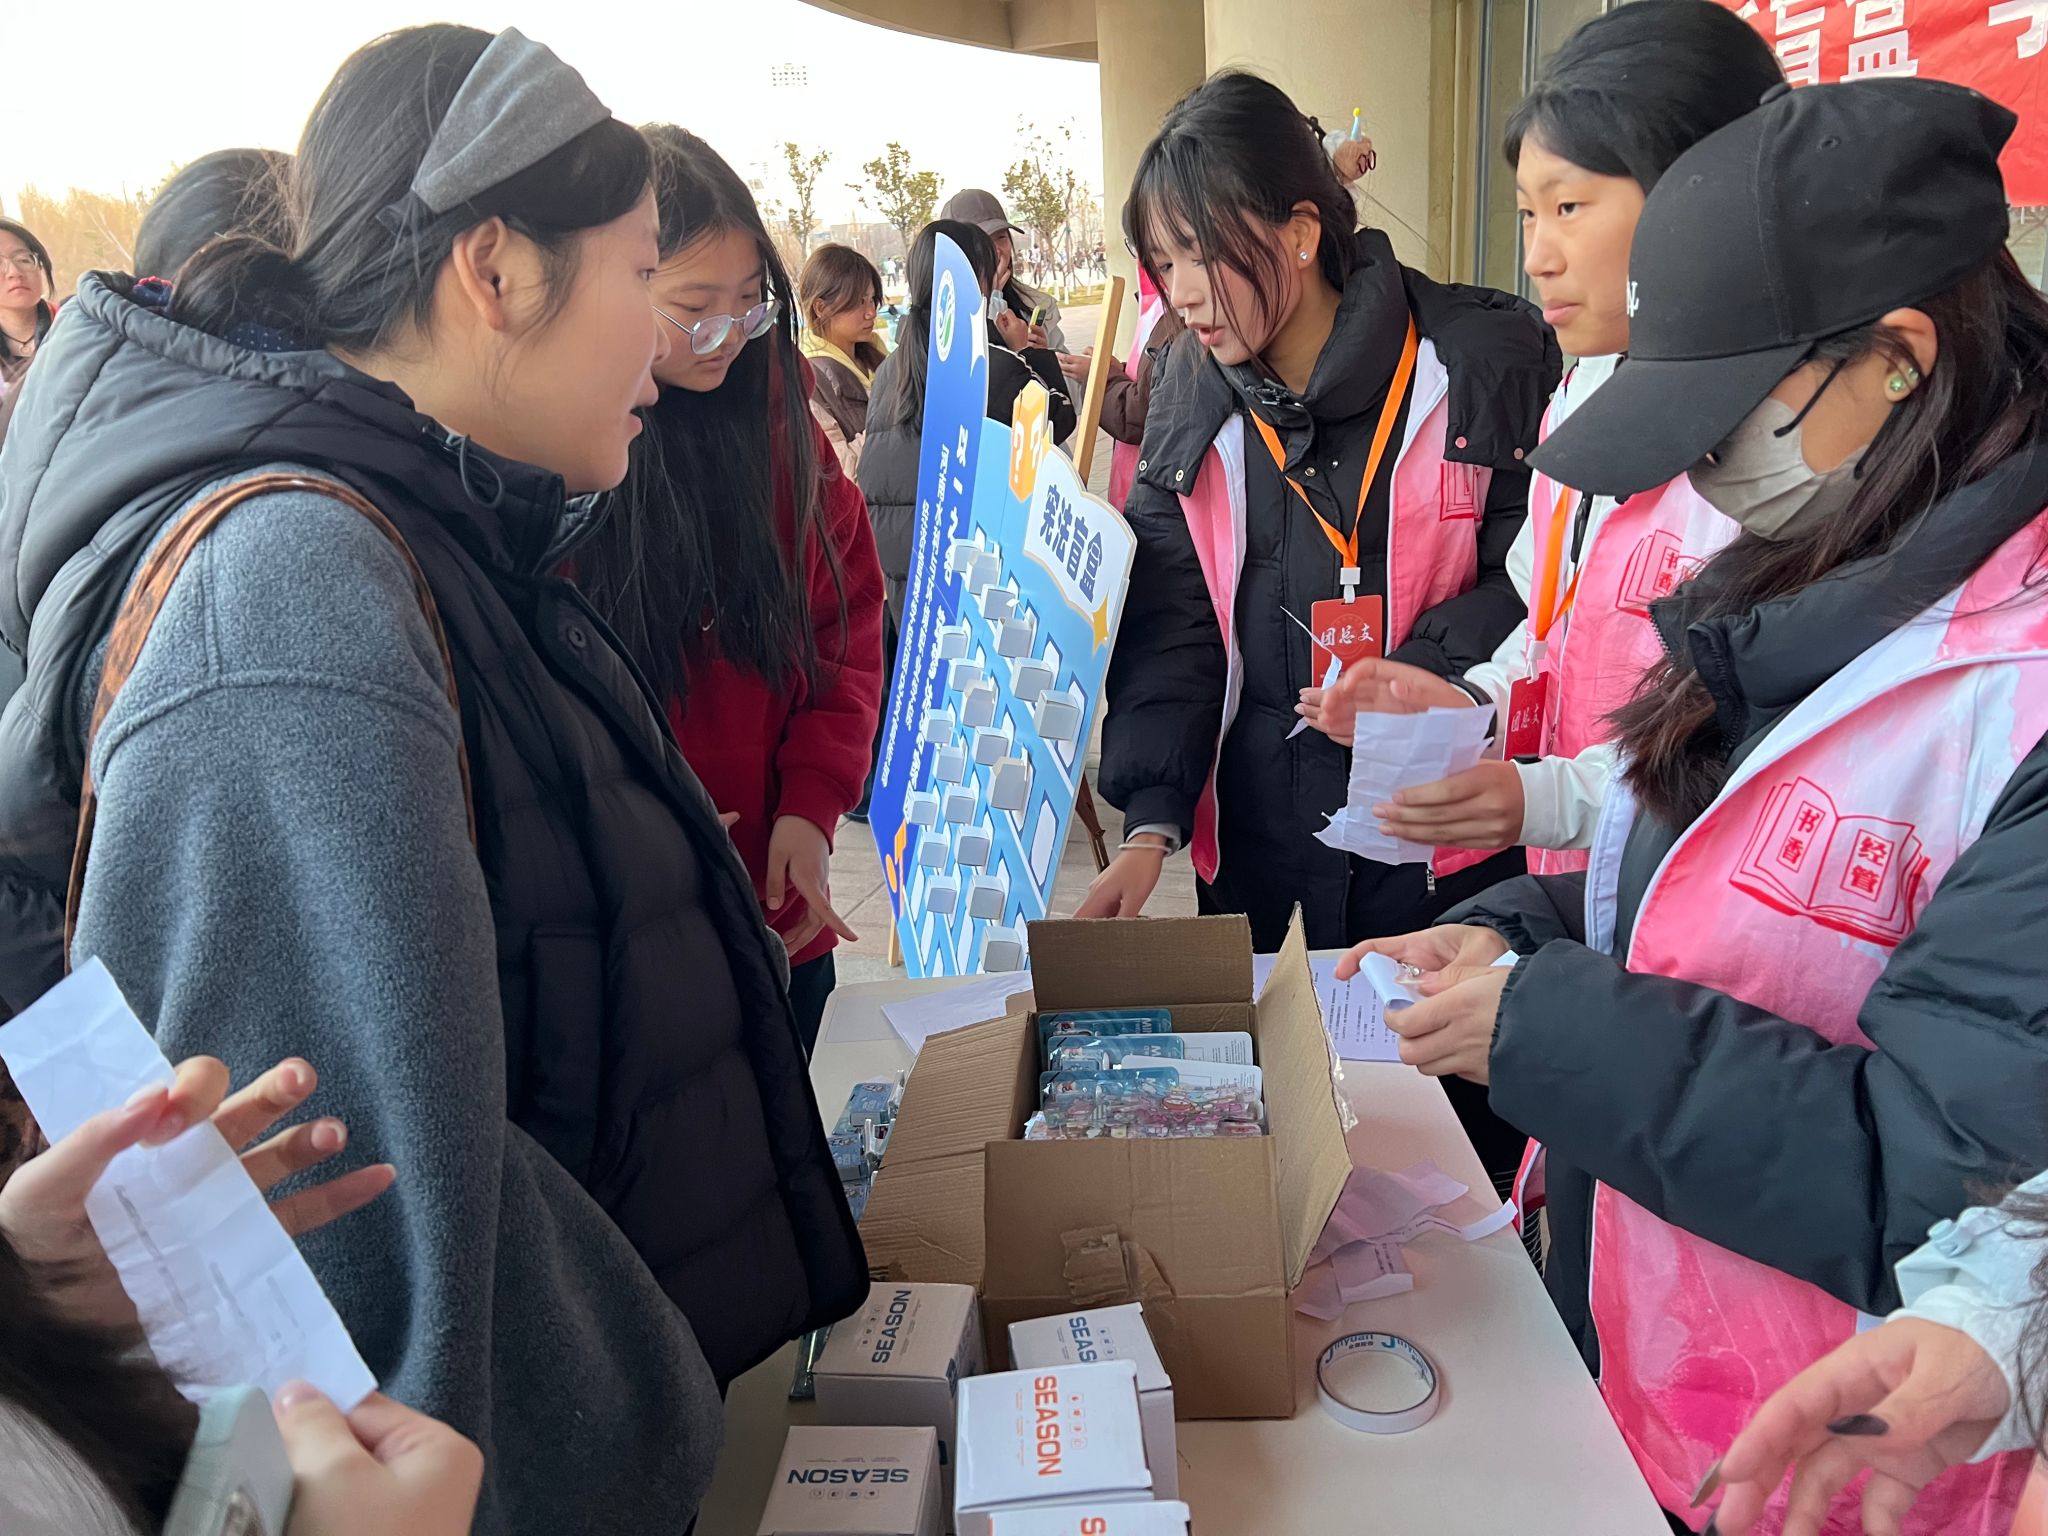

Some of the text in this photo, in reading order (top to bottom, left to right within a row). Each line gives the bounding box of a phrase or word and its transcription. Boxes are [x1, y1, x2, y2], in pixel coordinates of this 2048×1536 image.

[1040, 484, 1103, 603] 宪法盲盒
[1321, 623, 1374, 646] 团总支
[1781, 808, 1820, 865] 书香
[1850, 836, 1888, 894] 经管
[871, 1290, 912, 1363] SEASON
[1069, 1316, 1098, 1362] SEAS
[1034, 1376, 1062, 1476] SEASON
[787, 1468, 910, 1484] SEASON
